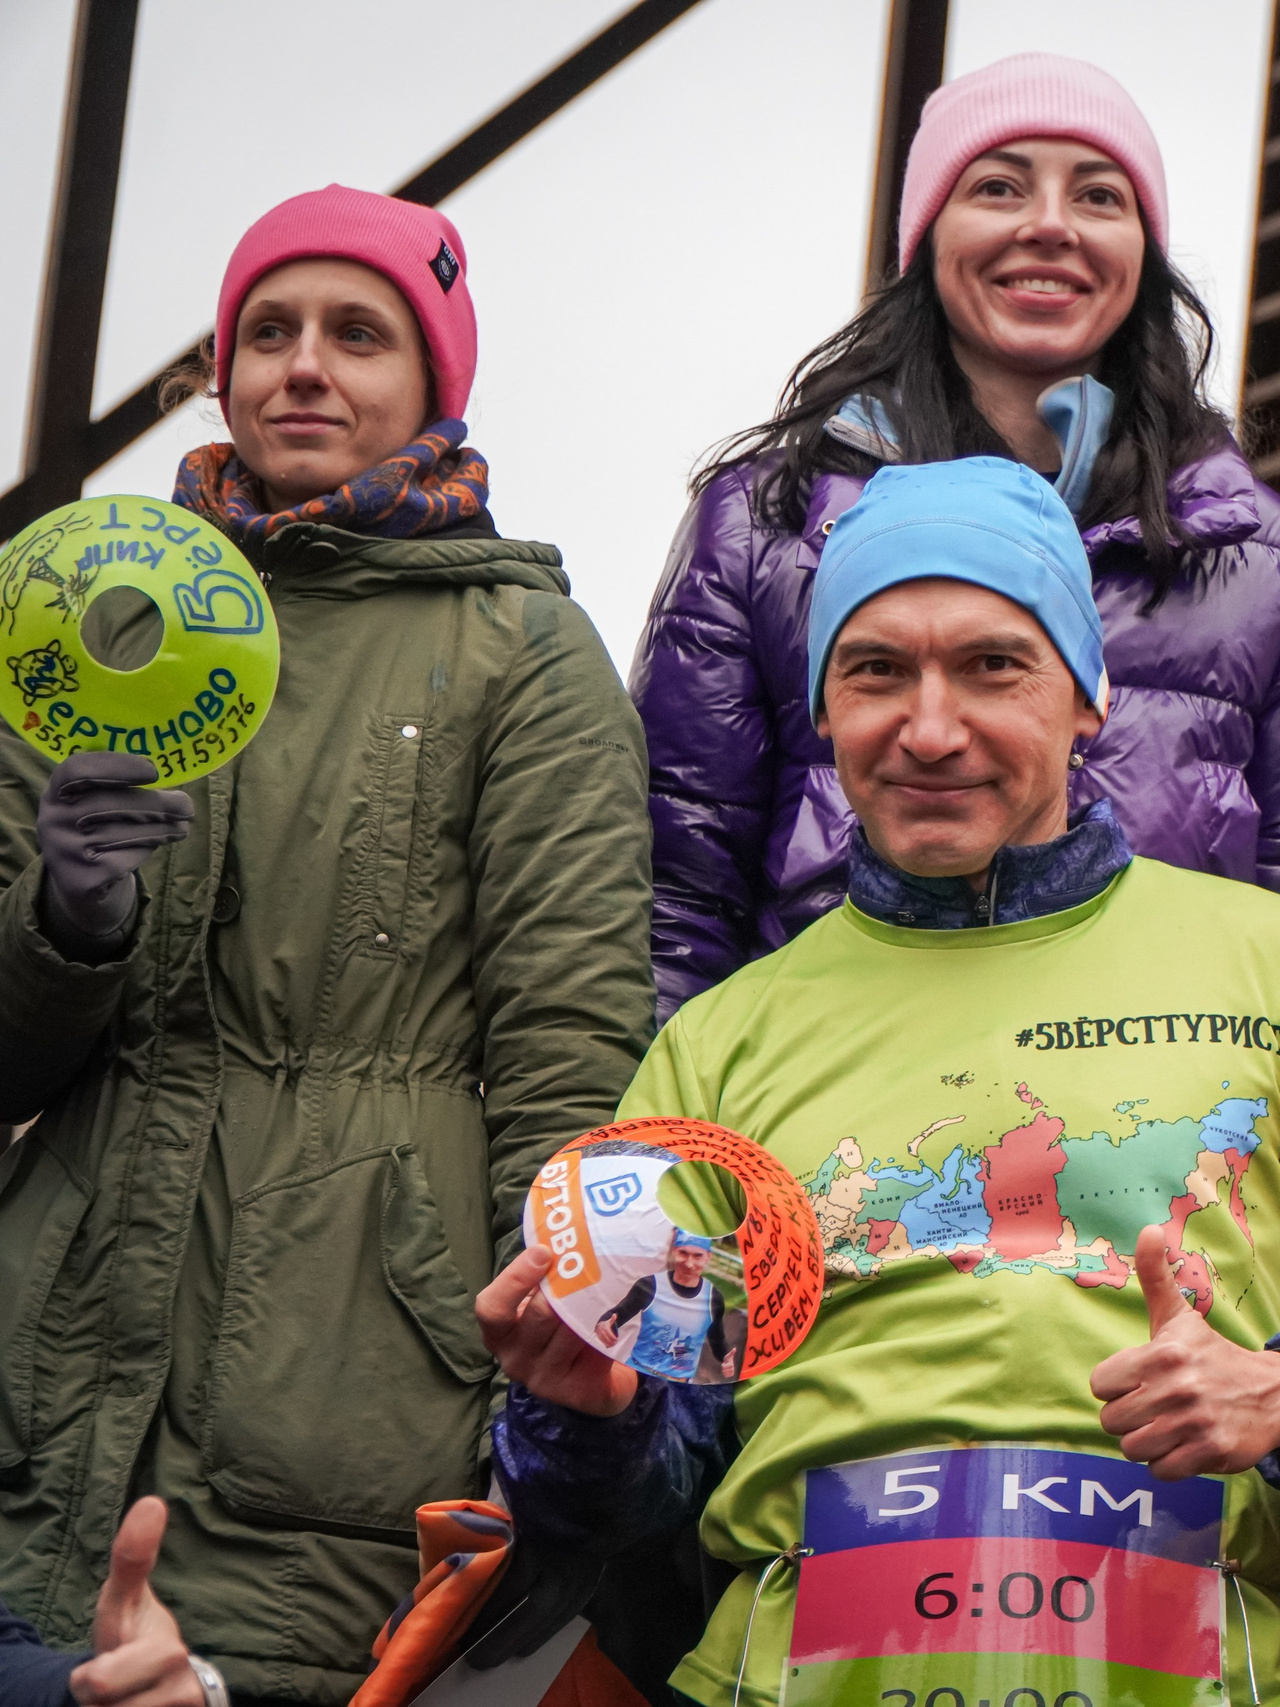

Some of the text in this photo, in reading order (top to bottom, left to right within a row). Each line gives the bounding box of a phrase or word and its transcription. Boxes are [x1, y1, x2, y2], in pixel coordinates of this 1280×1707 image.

[871, 1195, 901, 1206] КОМИ
[941, 1203, 983, 1215] НЕНЕЦКИЙ
[1080, 1187, 1159, 1200] ЯКУТИЯ
[540, 1160, 584, 1280] БУТОВО
[878, 1465, 941, 1517] 5
[914, 1571, 1096, 1624] 6:00
